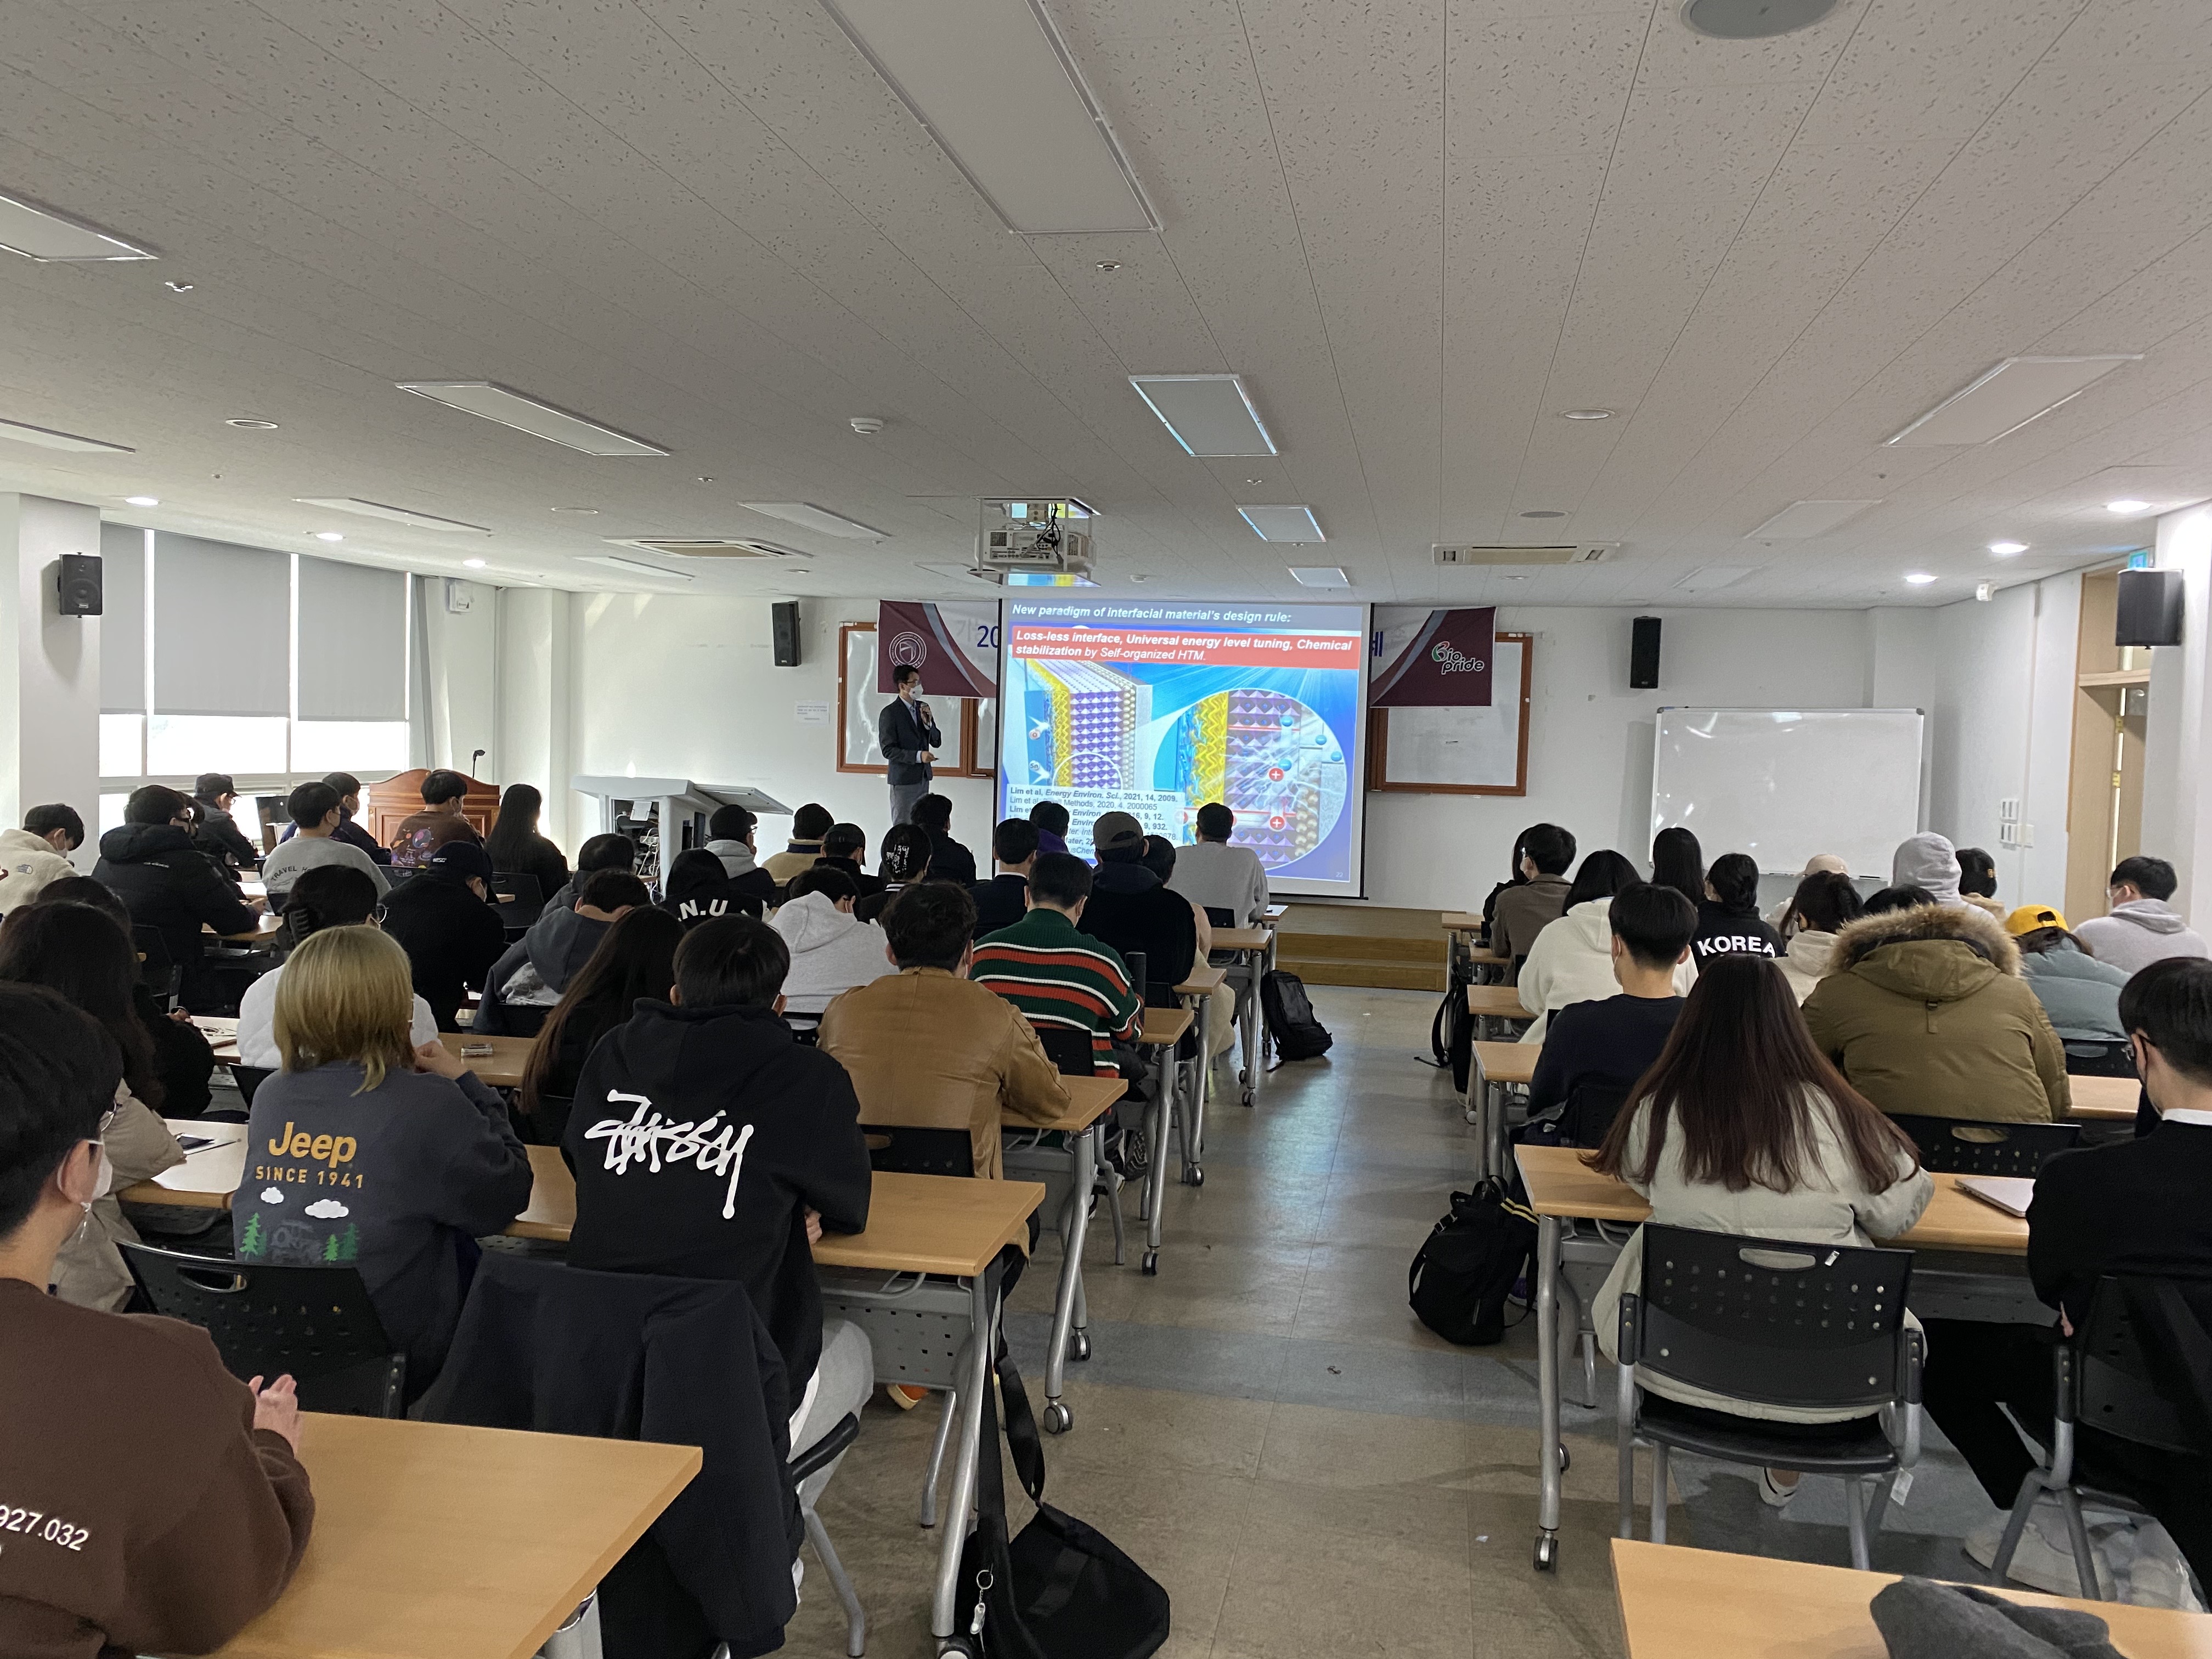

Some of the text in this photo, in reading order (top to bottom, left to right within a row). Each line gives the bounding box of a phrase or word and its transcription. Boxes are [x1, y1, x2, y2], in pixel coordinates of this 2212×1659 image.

[1012, 604, 1292, 624] New paradigm of interfacial material's design rule:
[1016, 630, 1352, 651] Loss-less interface, Universal energy level tuning, Chemical
[1015, 645, 1206, 661] stabilization by Self-organized HTM.
[1441, 657, 1485, 675] pride
[1045, 789, 1071, 798] Energy
[1073, 791, 1103, 799] Environ.
[1124, 793, 1143, 801] 2021,
[1064, 799, 1095, 808] Methods,
[1127, 802, 1158, 810] 2000065
[270, 866, 297, 881] TRAVEL
[1697, 935, 1776, 958] KOREA
[268, 1121, 357, 1168] Jeep
[255, 1165, 363, 1188] SINCE 1941
